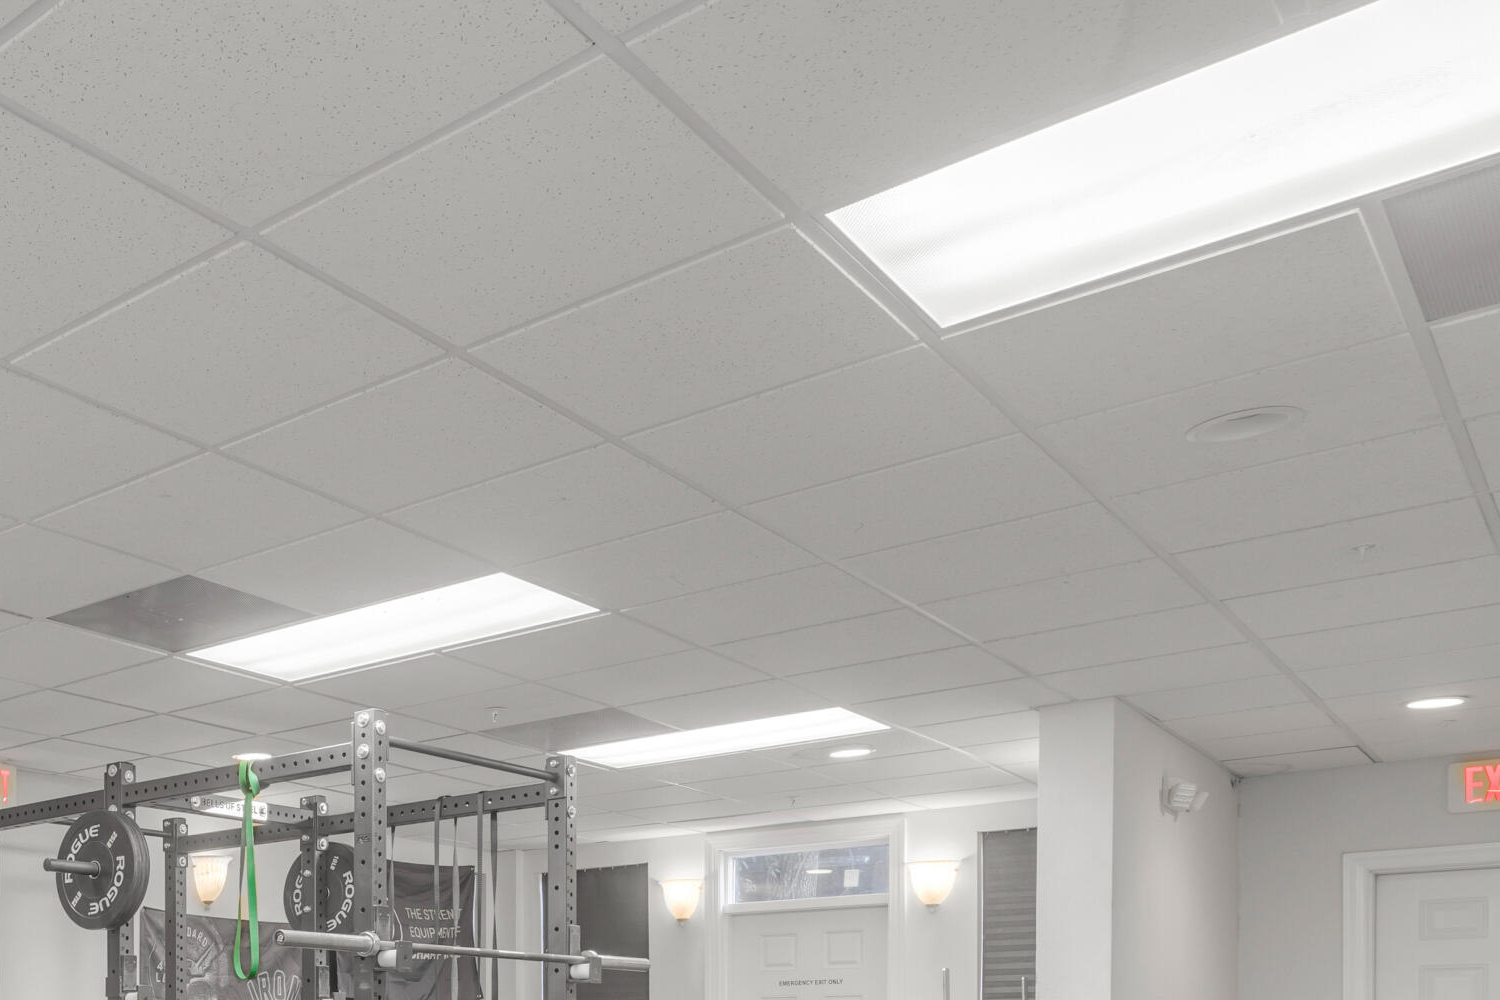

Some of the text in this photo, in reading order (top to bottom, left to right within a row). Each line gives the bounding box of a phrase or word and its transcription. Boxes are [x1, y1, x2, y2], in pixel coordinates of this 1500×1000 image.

[236, 803, 258, 815] STEL
[87, 855, 125, 916] ROGUE
[326, 870, 355, 932] ROGUE
[405, 907, 423, 920] THE
